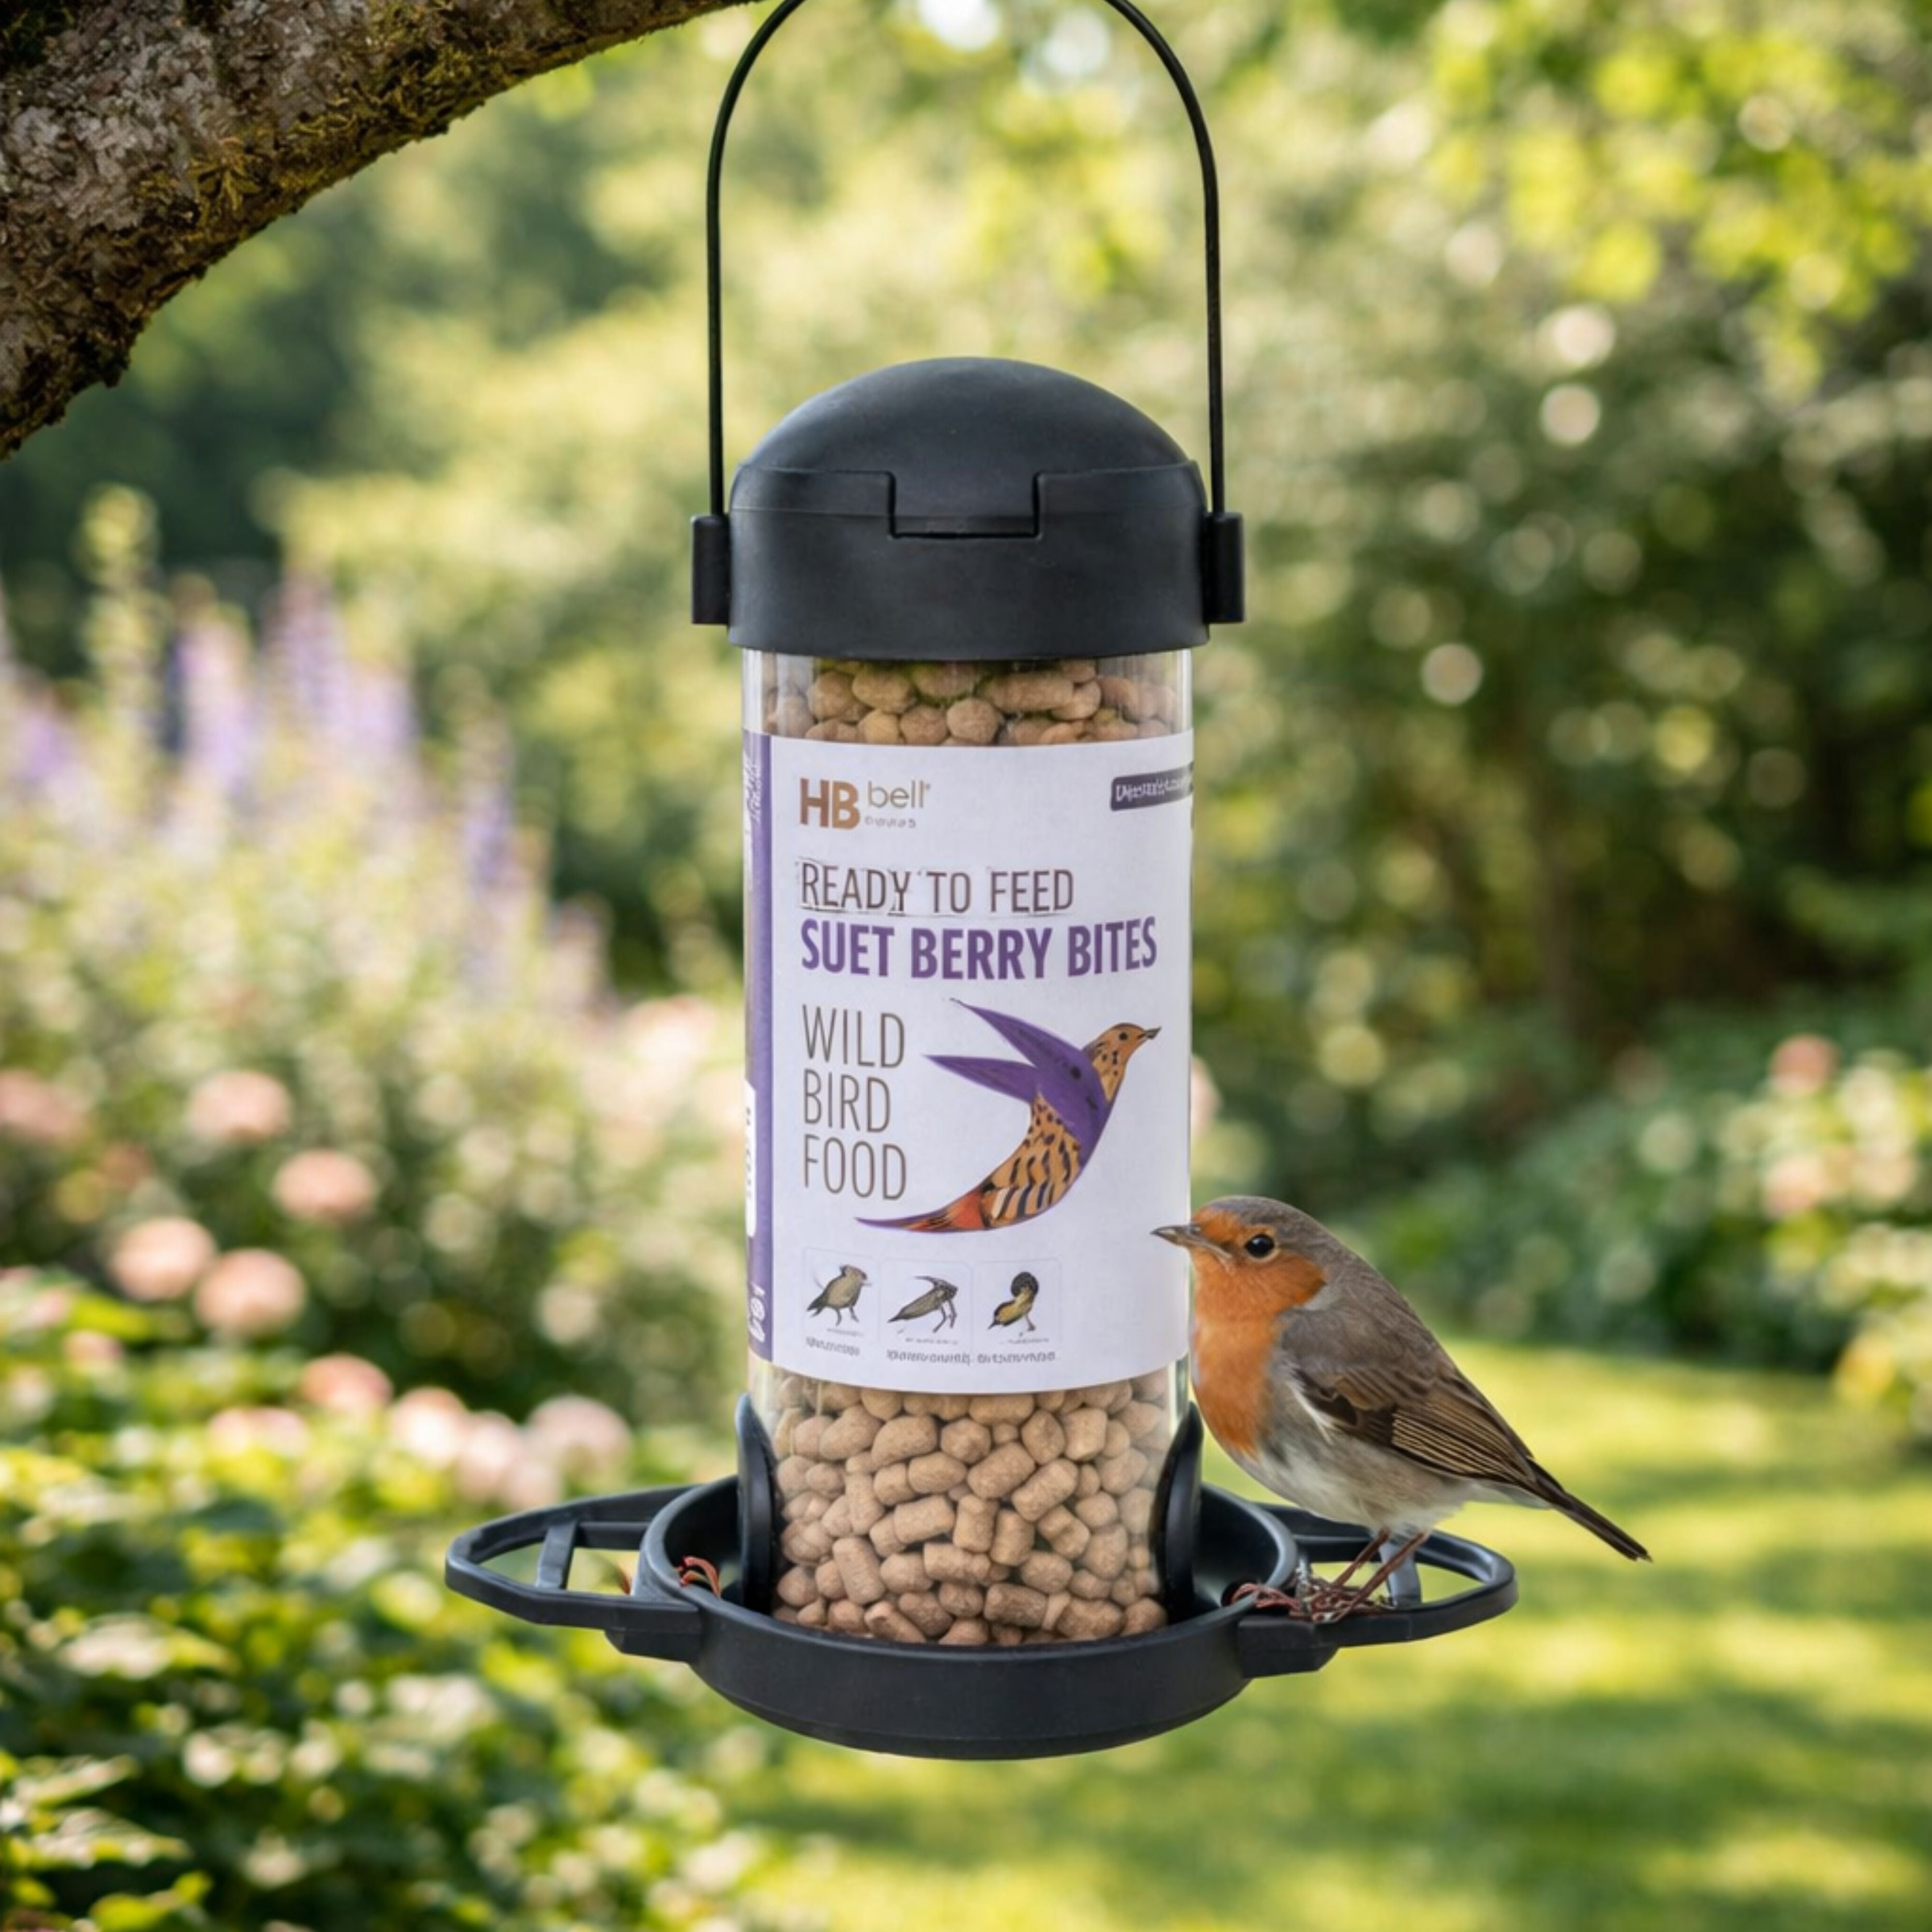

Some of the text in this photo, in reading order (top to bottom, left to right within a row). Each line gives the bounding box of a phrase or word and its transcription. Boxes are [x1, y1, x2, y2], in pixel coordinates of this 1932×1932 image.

[799, 778, 861, 830] HB
[802, 862, 1074, 913] READY TO FEED
[801, 916, 1157, 979] SUET BERRY BITES
[802, 1004, 905, 1069] WILD
[803, 1068, 891, 1133] BIRD
[804, 1134, 906, 1201] FOOD
